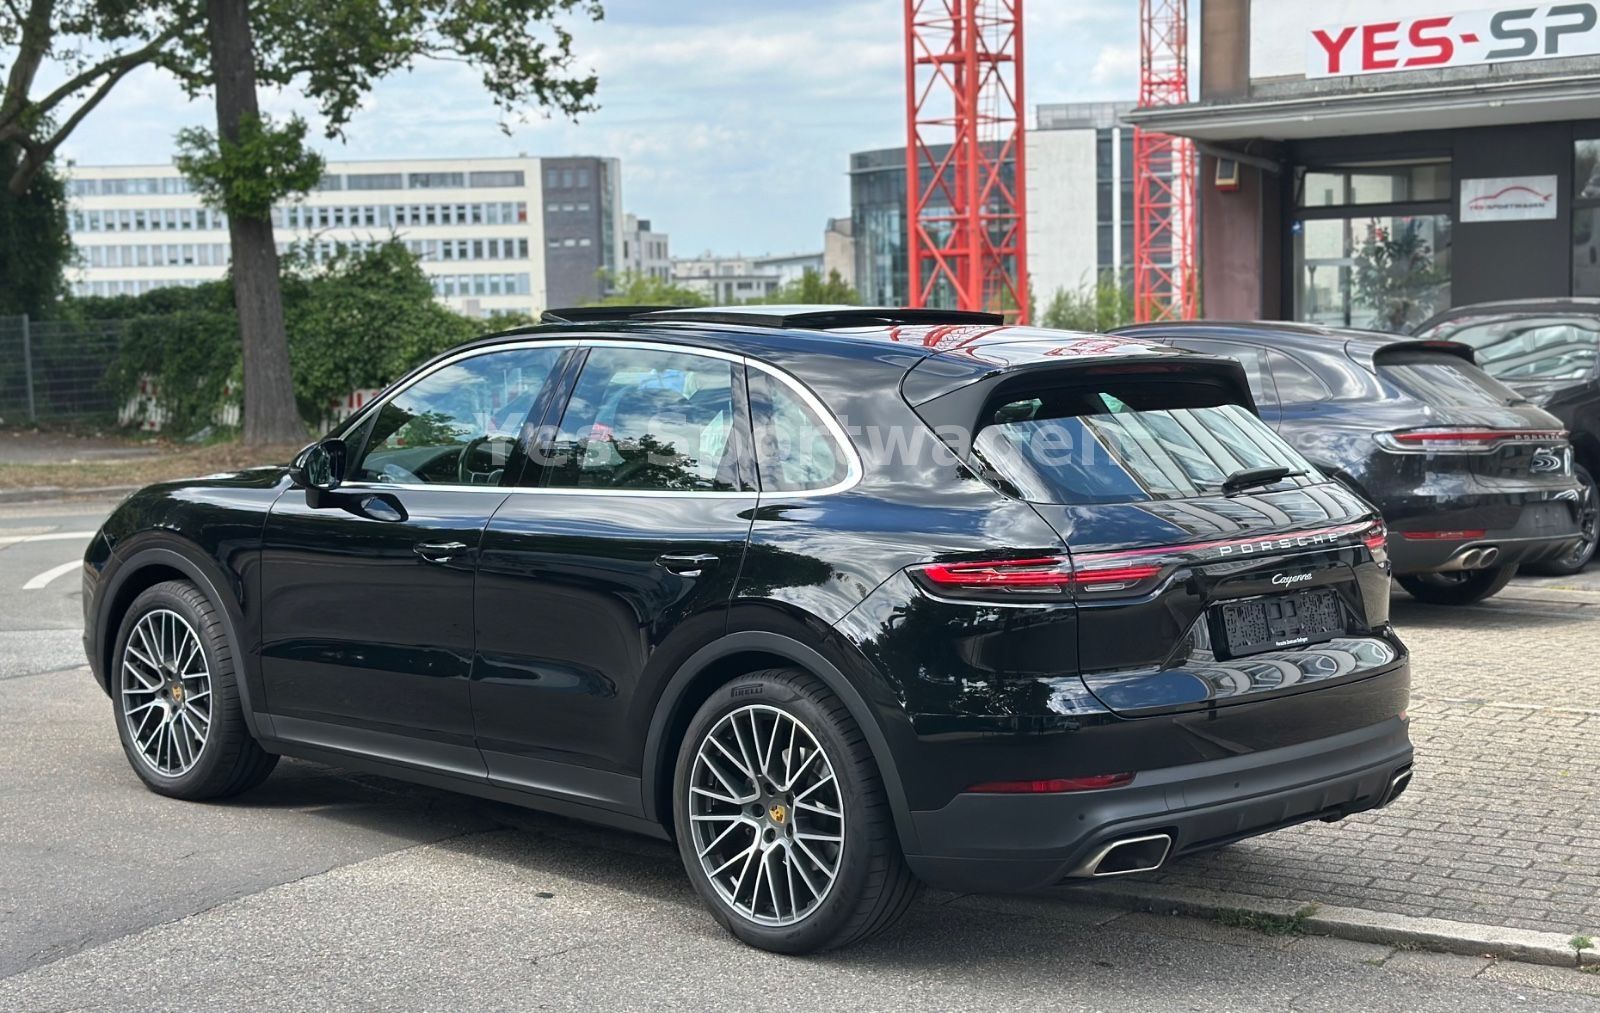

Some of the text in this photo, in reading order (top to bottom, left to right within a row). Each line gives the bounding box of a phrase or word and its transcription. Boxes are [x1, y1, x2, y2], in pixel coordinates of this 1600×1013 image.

[1311, 3, 1598, 74] YES-SP
[1219, 533, 1339, 557] PORSCHE
[1271, 572, 1313, 588] Cayenne
[730, 683, 764, 698] PIRELLI
